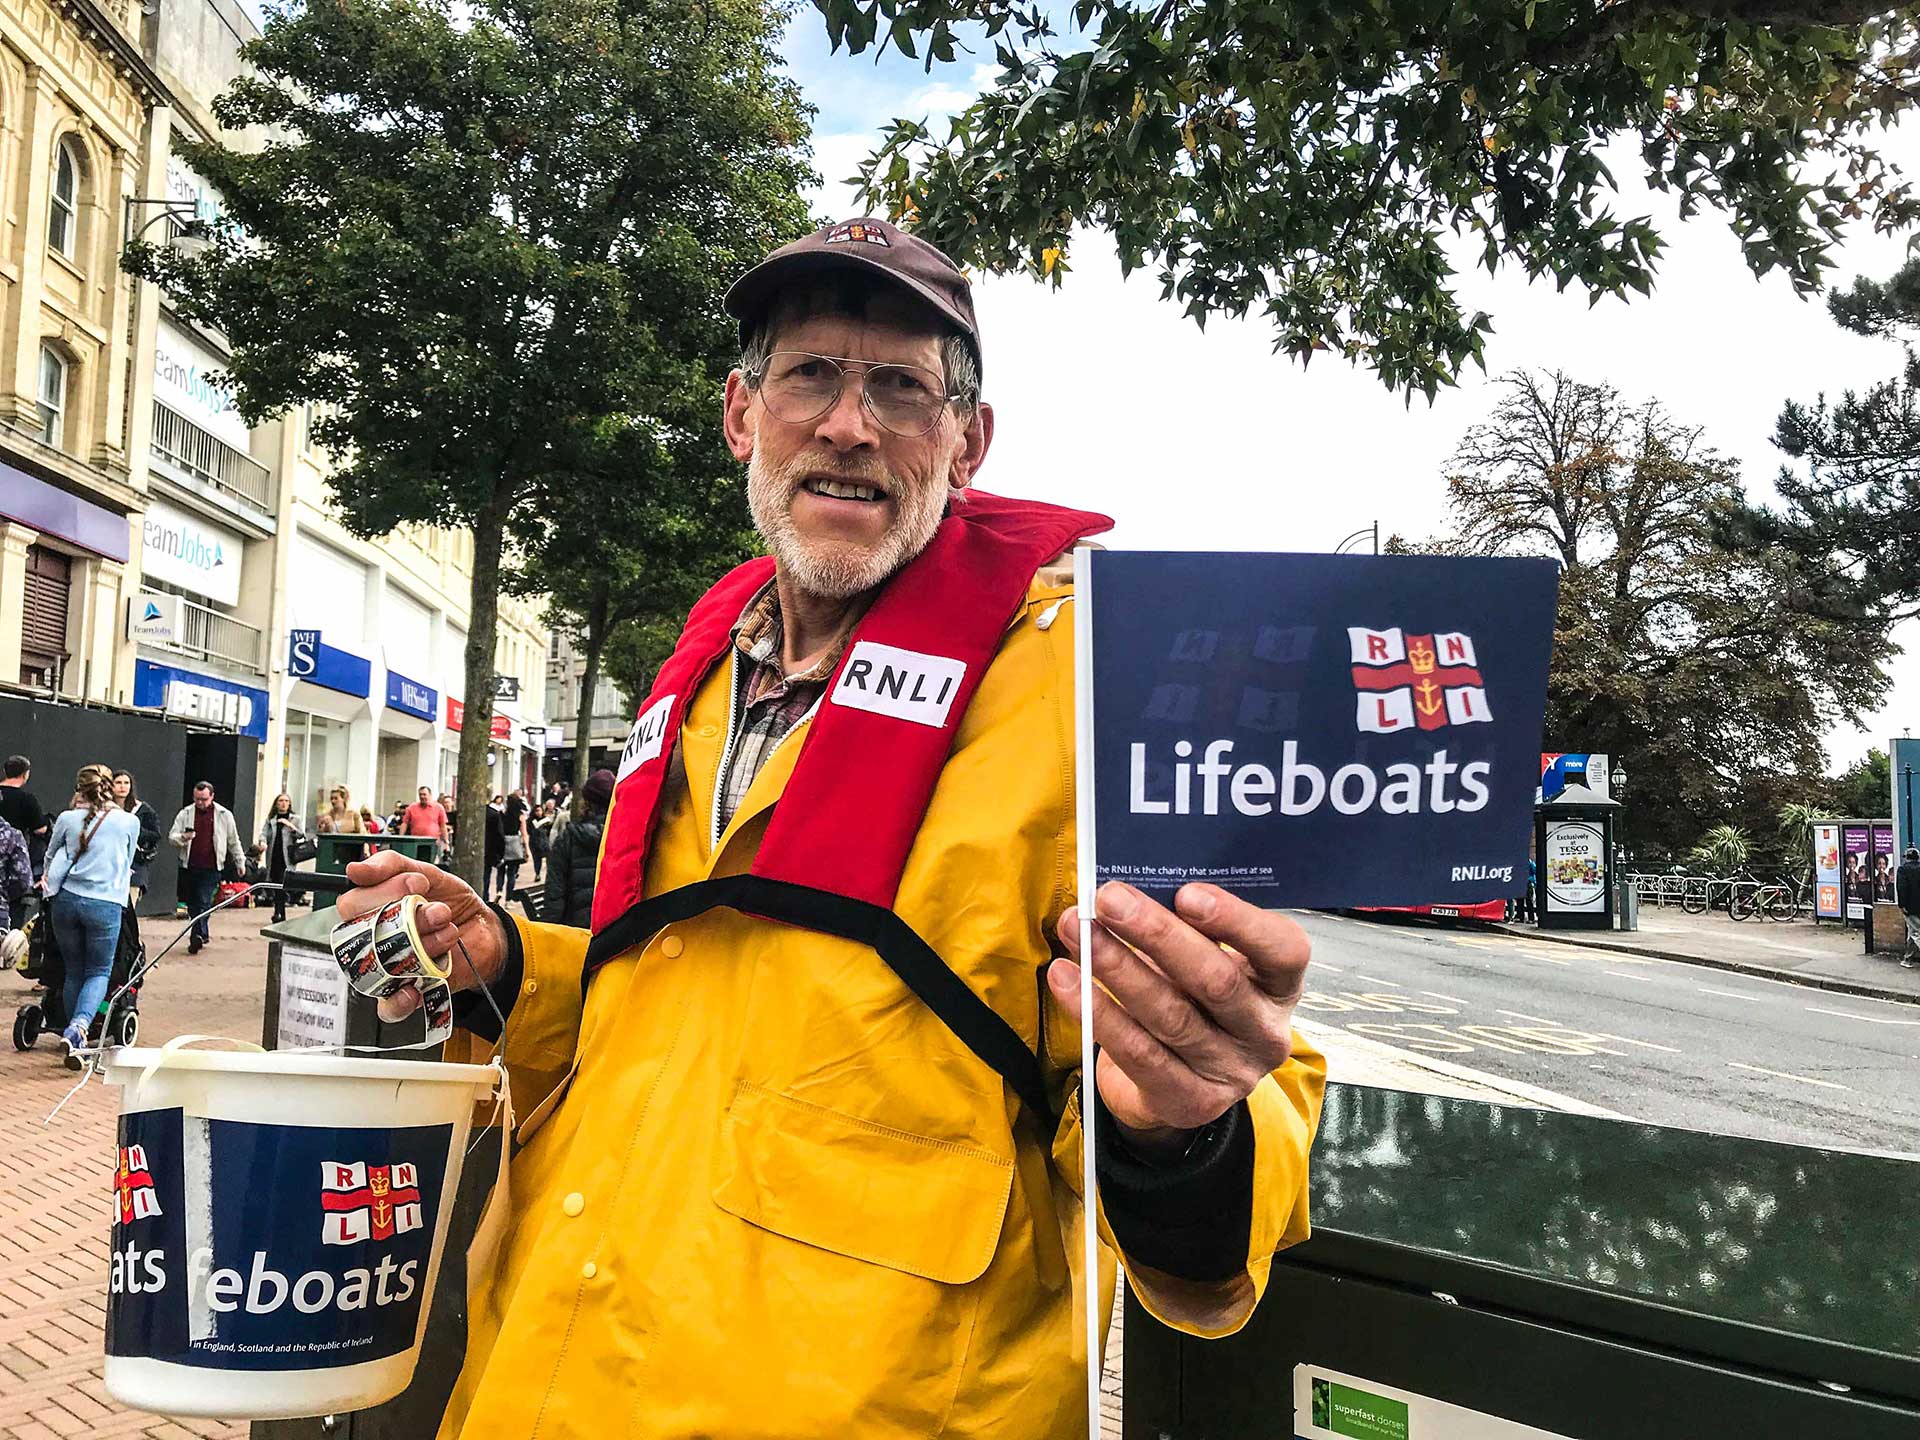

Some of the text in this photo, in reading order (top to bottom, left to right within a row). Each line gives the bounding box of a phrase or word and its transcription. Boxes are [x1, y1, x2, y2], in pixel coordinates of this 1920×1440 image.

[144, 519, 212, 571] eamJobs
[843, 659, 953, 705] RNLI
[622, 709, 668, 763] RNLI
[1129, 739, 1491, 816] Lifeboats
[1556, 833, 1589, 842] Exclusively
[1559, 845, 1589, 854] TESCO
[1096, 864, 1110, 874] The
[1111, 865, 1132, 875] RNLI
[1133, 865, 1141, 875] is
[1142, 865, 1157, 875] the
[1157, 865, 1188, 878] charity
[1189, 866, 1208, 876] that
[1208, 868, 1230, 876] saves
[1230, 866, 1249, 875] lives
[1249, 867, 1258, 875] at
[1451, 865, 1513, 882] RNLI.org
[193, 1335, 374, 1353] in England, Scotland and the Republic of Ireland
[1333, 1402, 1406, 1431] superfast dorset
